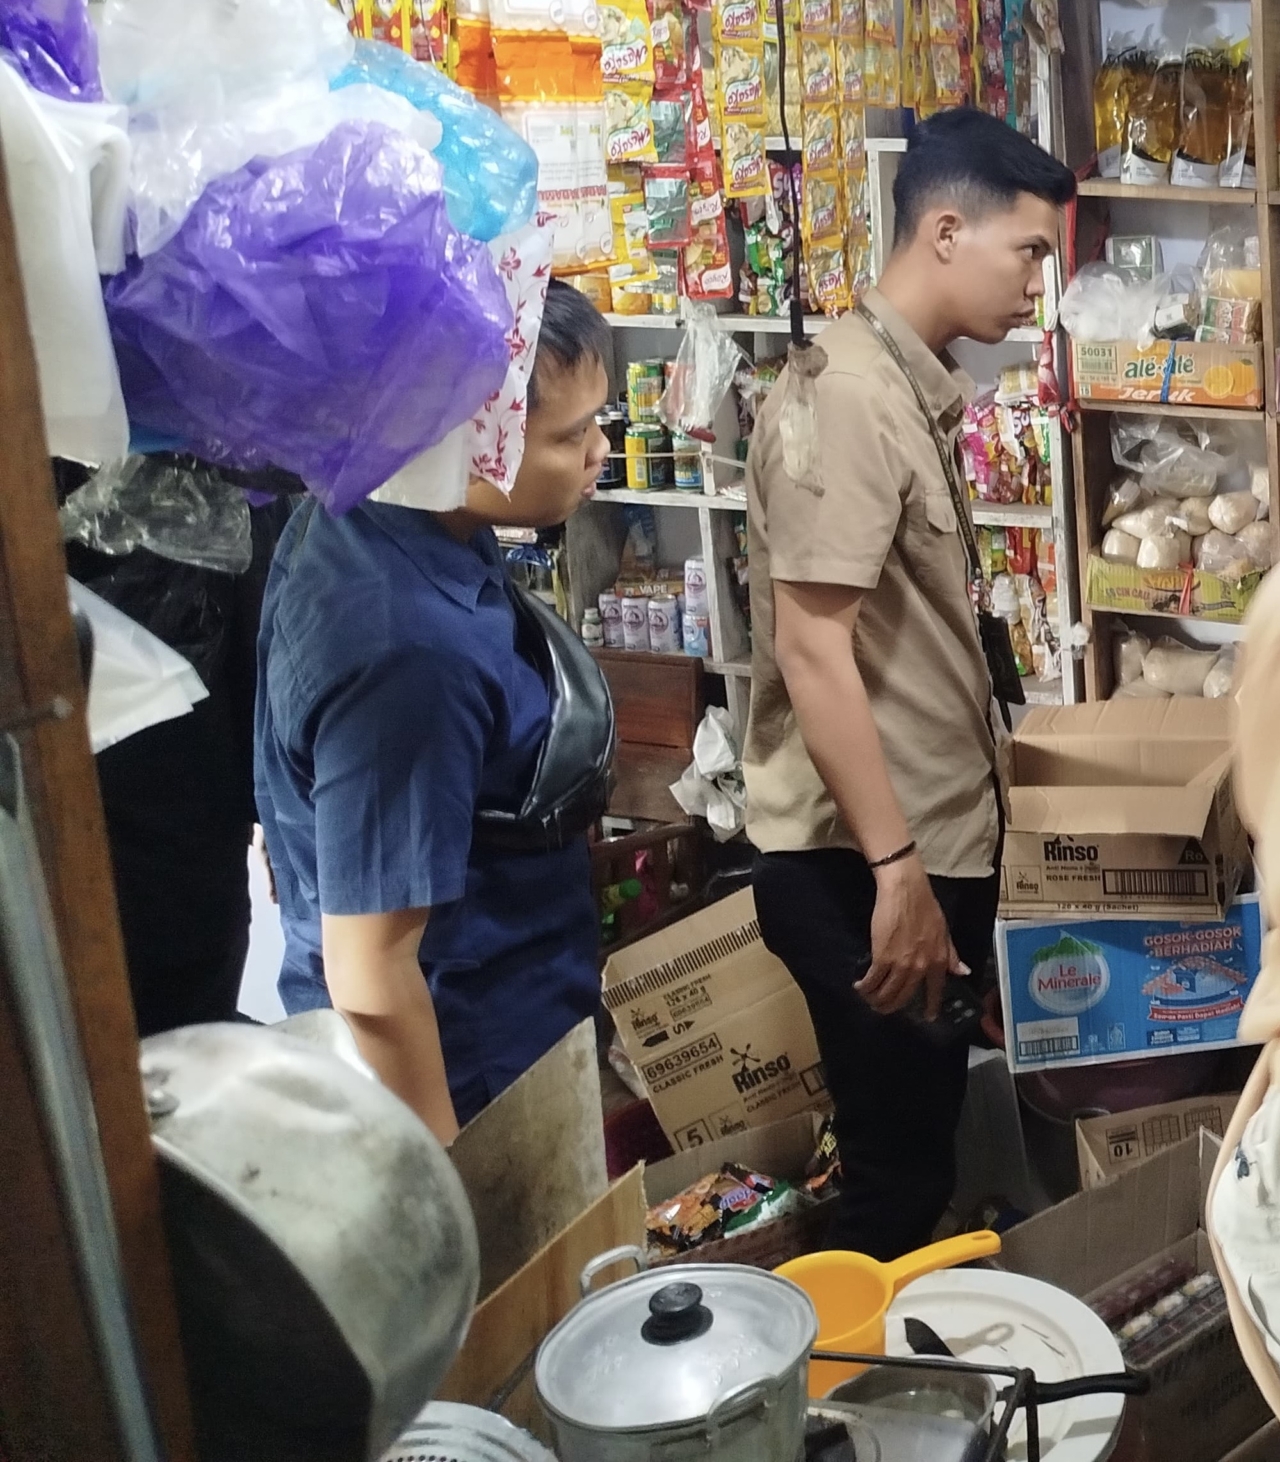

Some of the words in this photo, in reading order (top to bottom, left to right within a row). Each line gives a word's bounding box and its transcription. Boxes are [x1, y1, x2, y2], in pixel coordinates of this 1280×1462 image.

[1081, 344, 1112, 358] 50031
[639, 584, 668, 595] VAPE
[1043, 839, 1099, 862] Rinso
[1046, 874, 1070, 882] ROSE
[1072, 874, 1101, 882] FRESH
[1102, 903, 1139, 913] (Sachet)
[1143, 925, 1242, 947] GOSOK-GOSOK
[1154, 939, 1233, 958] BERHADIAH
[1059, 964, 1077, 978] Le
[1037, 973, 1102, 991] Minerale
[646, 1038, 718, 1079] 69639654
[653, 1070, 692, 1093] CLASSIC
[693, 1055, 724, 1076] FRESH
[732, 1054, 791, 1094] Rinso
[687, 1128, 704, 1148] 5
[1113, 1142, 1133, 1158] 10
